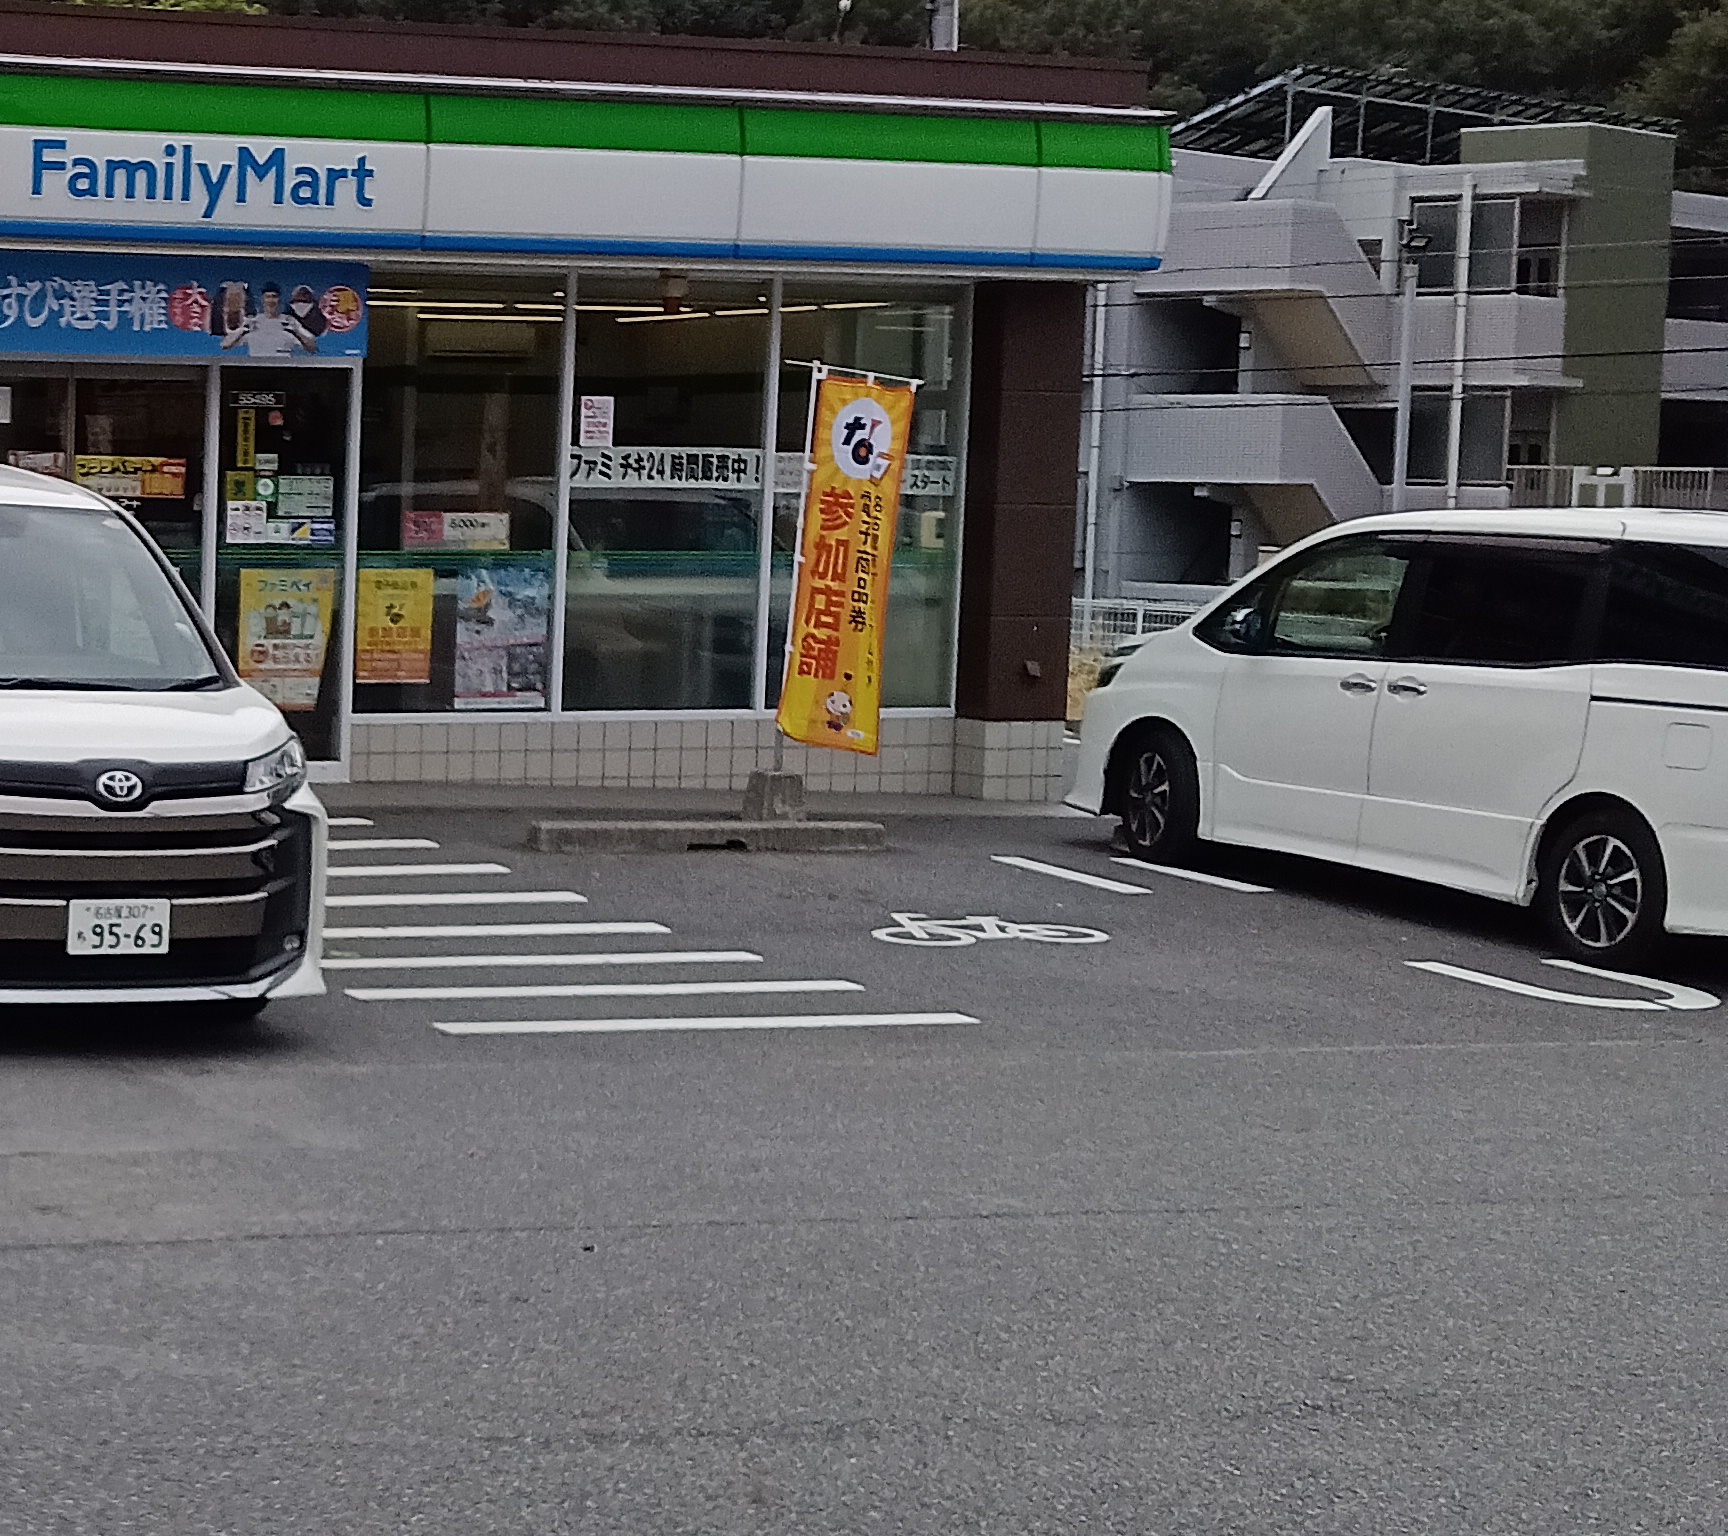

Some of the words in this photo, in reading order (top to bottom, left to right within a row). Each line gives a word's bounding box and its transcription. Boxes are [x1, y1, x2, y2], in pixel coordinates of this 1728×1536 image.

[31, 139, 375, 219] FamilyMart
[797, 486, 855, 680] 参加店舗
[91, 923, 163, 949] 95-69
